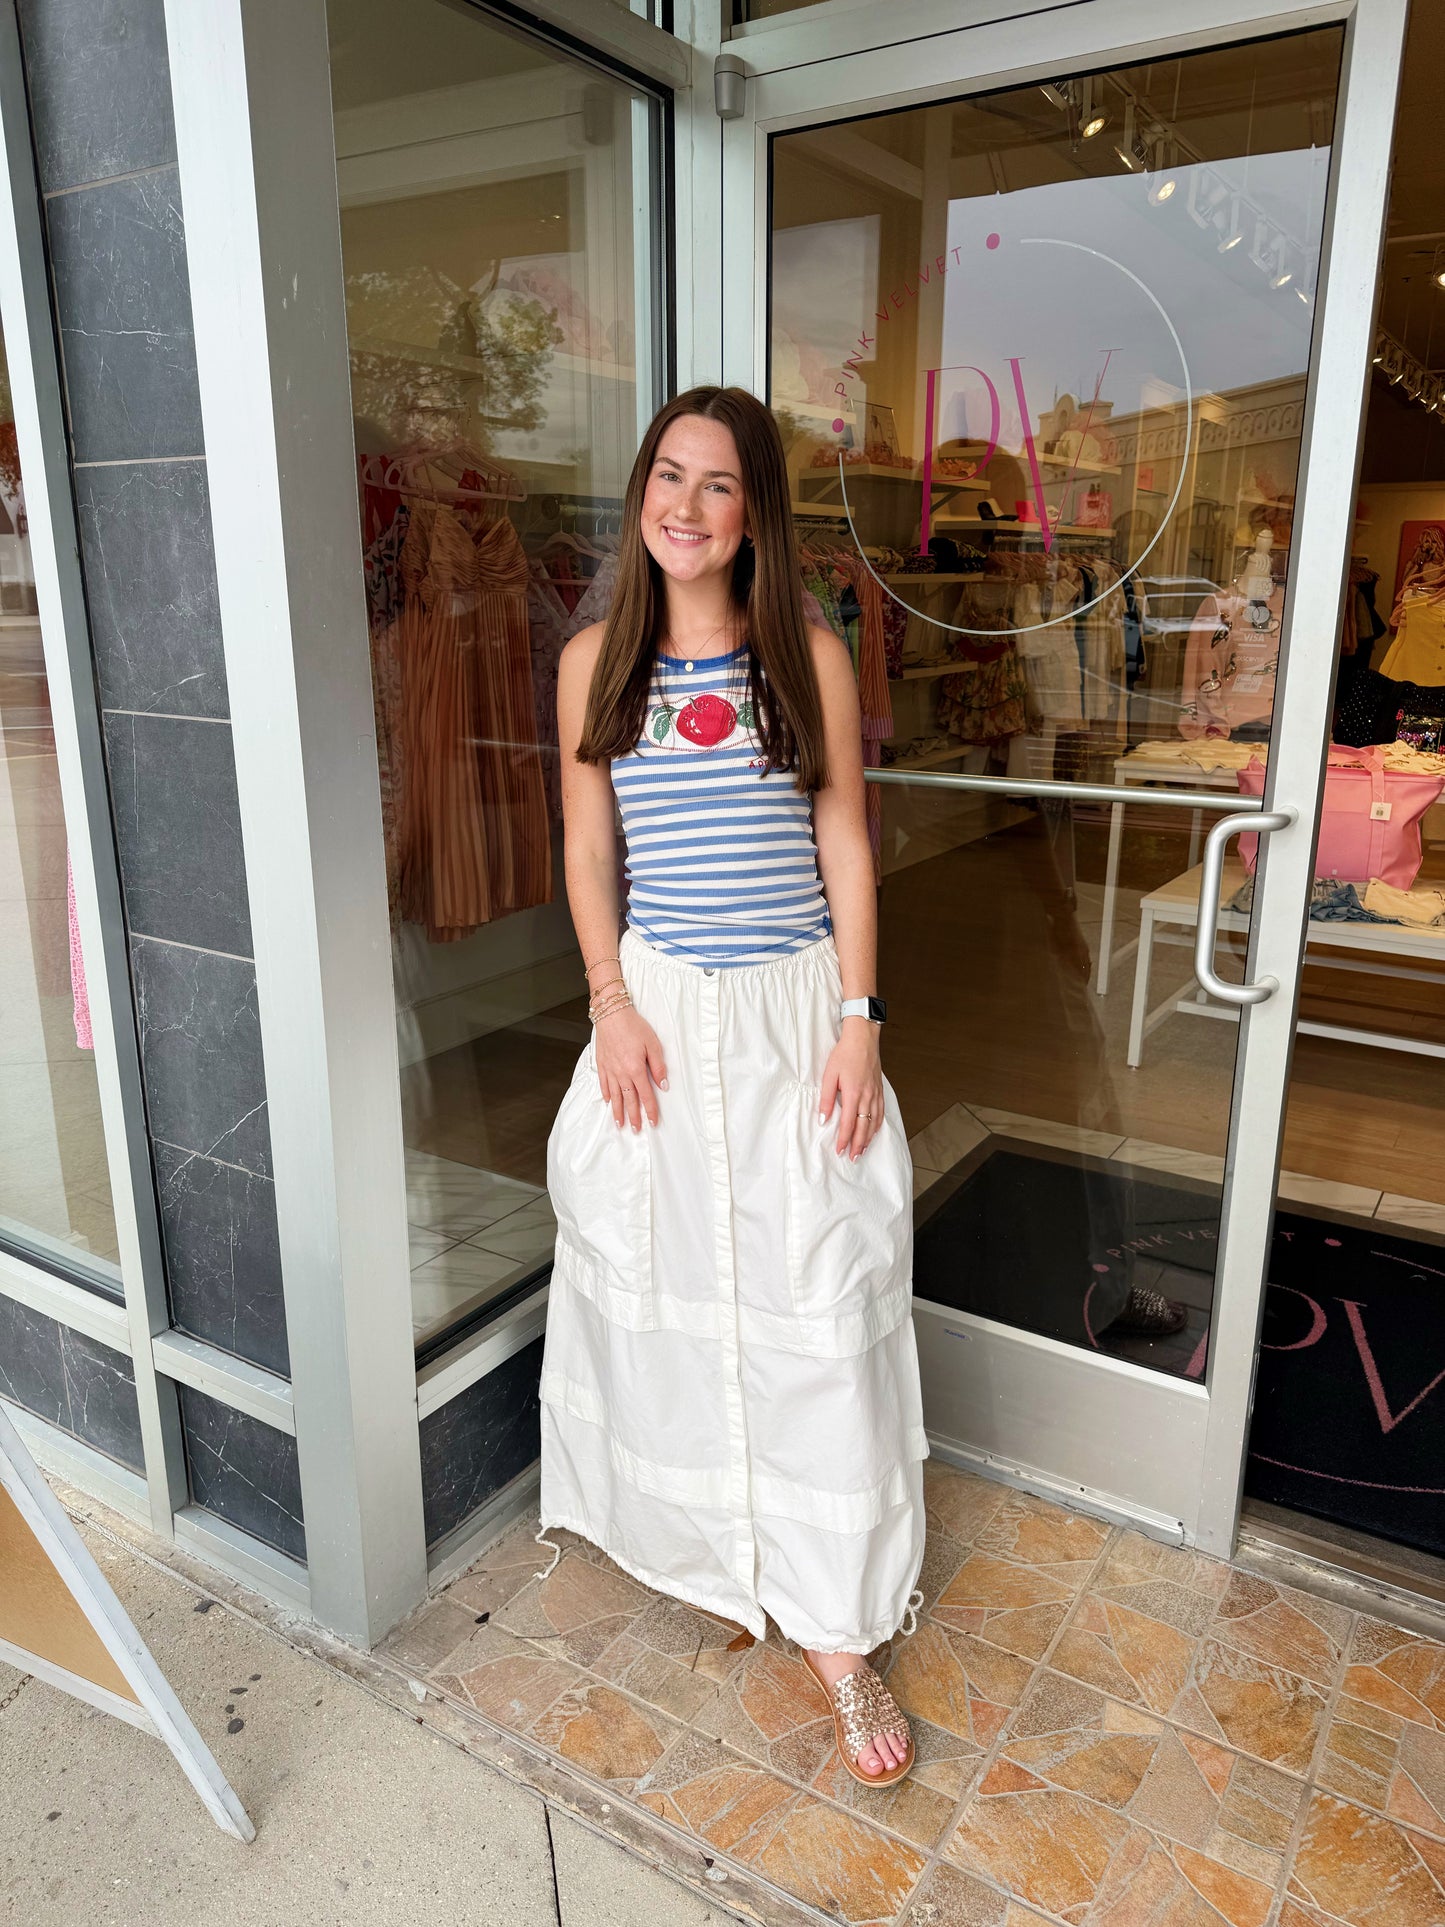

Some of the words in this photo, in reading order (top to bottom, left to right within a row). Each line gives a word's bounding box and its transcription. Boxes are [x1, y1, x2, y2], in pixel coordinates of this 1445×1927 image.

[834, 330, 875, 397] PINK
[875, 246, 962, 321] VELVET
[917, 348, 1124, 557] PV
[1243, 633, 1265, 642] VISA
[1106, 1234, 1172, 1259] PINK
